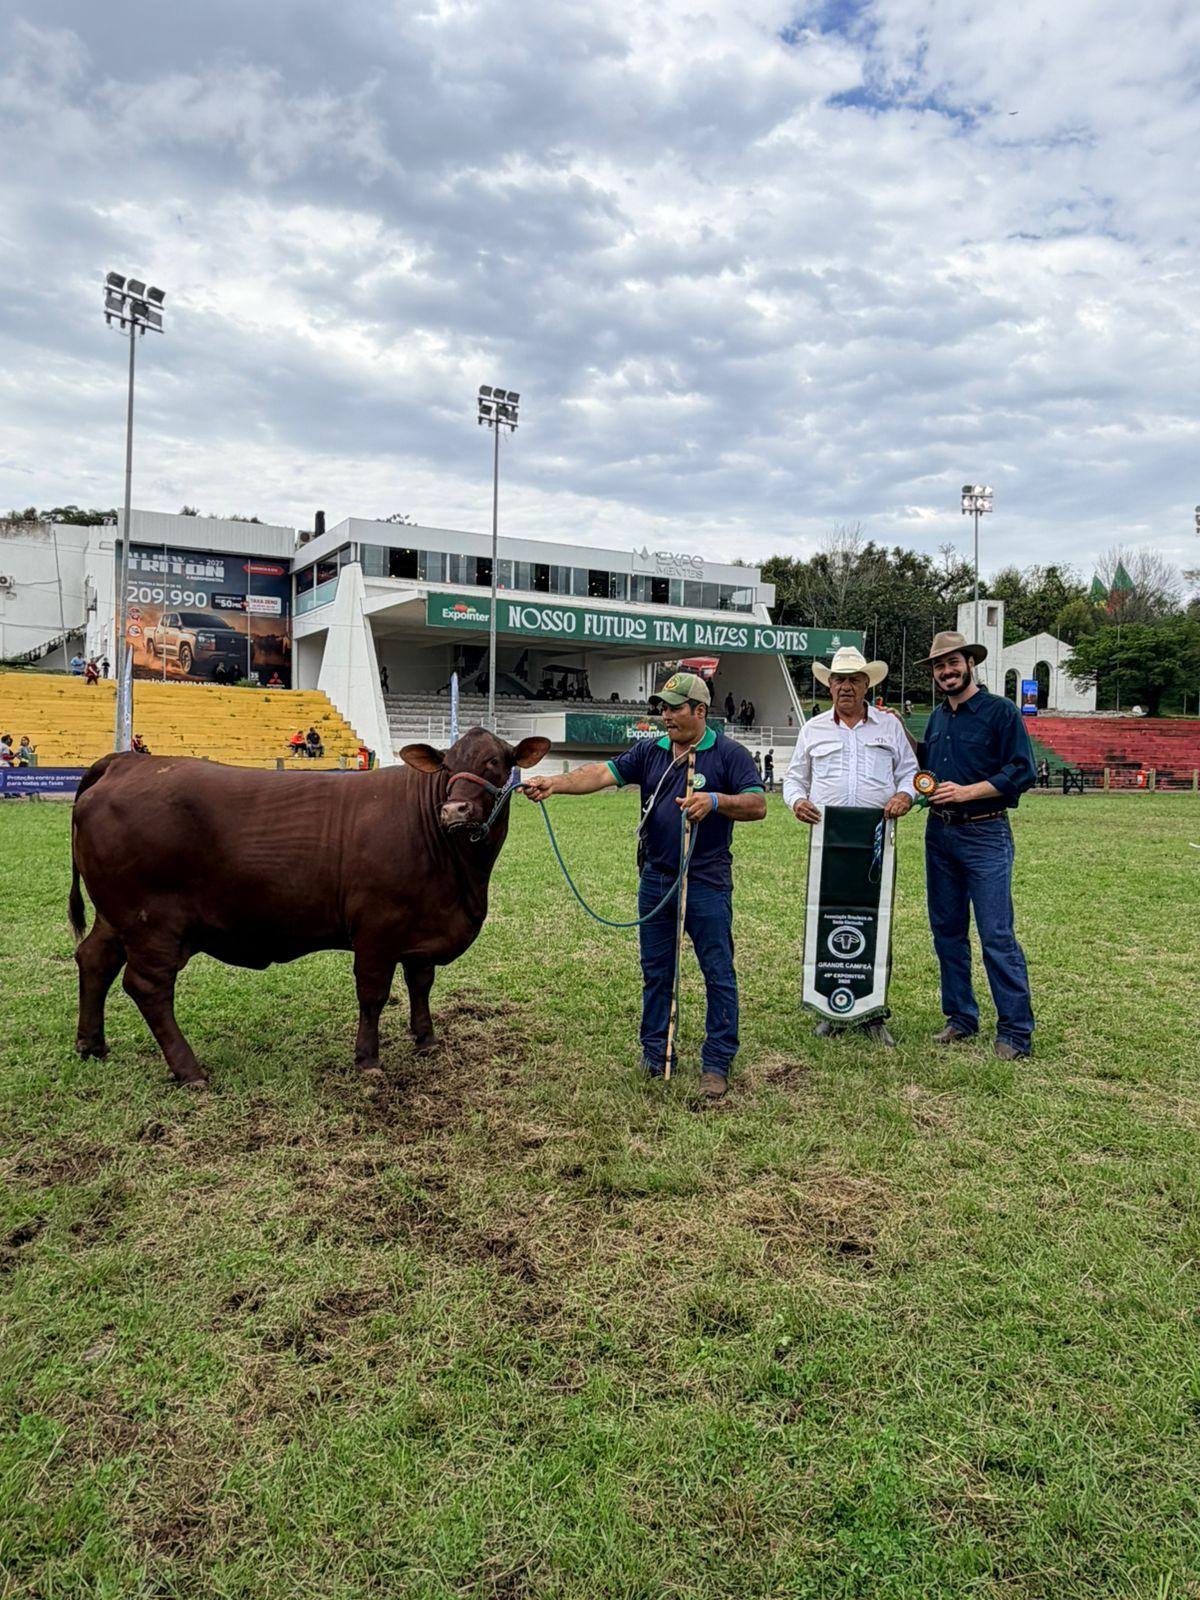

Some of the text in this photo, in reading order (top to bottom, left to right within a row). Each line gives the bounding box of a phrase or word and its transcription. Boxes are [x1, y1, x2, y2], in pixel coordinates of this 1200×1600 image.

[127, 558, 225, 578] TRITON
[656, 551, 704, 569] EXPO
[656, 566, 704, 580] MENTES
[127, 586, 207, 608] 209.990
[442, 608, 489, 622] Expointer
[508, 605, 576, 633] NOSSO
[584, 613, 647, 639] FUTURO
[653, 620, 688, 643] TEM
[754, 629, 808, 651] FORTES
[845, 962, 872, 970] CAMPEÃ
